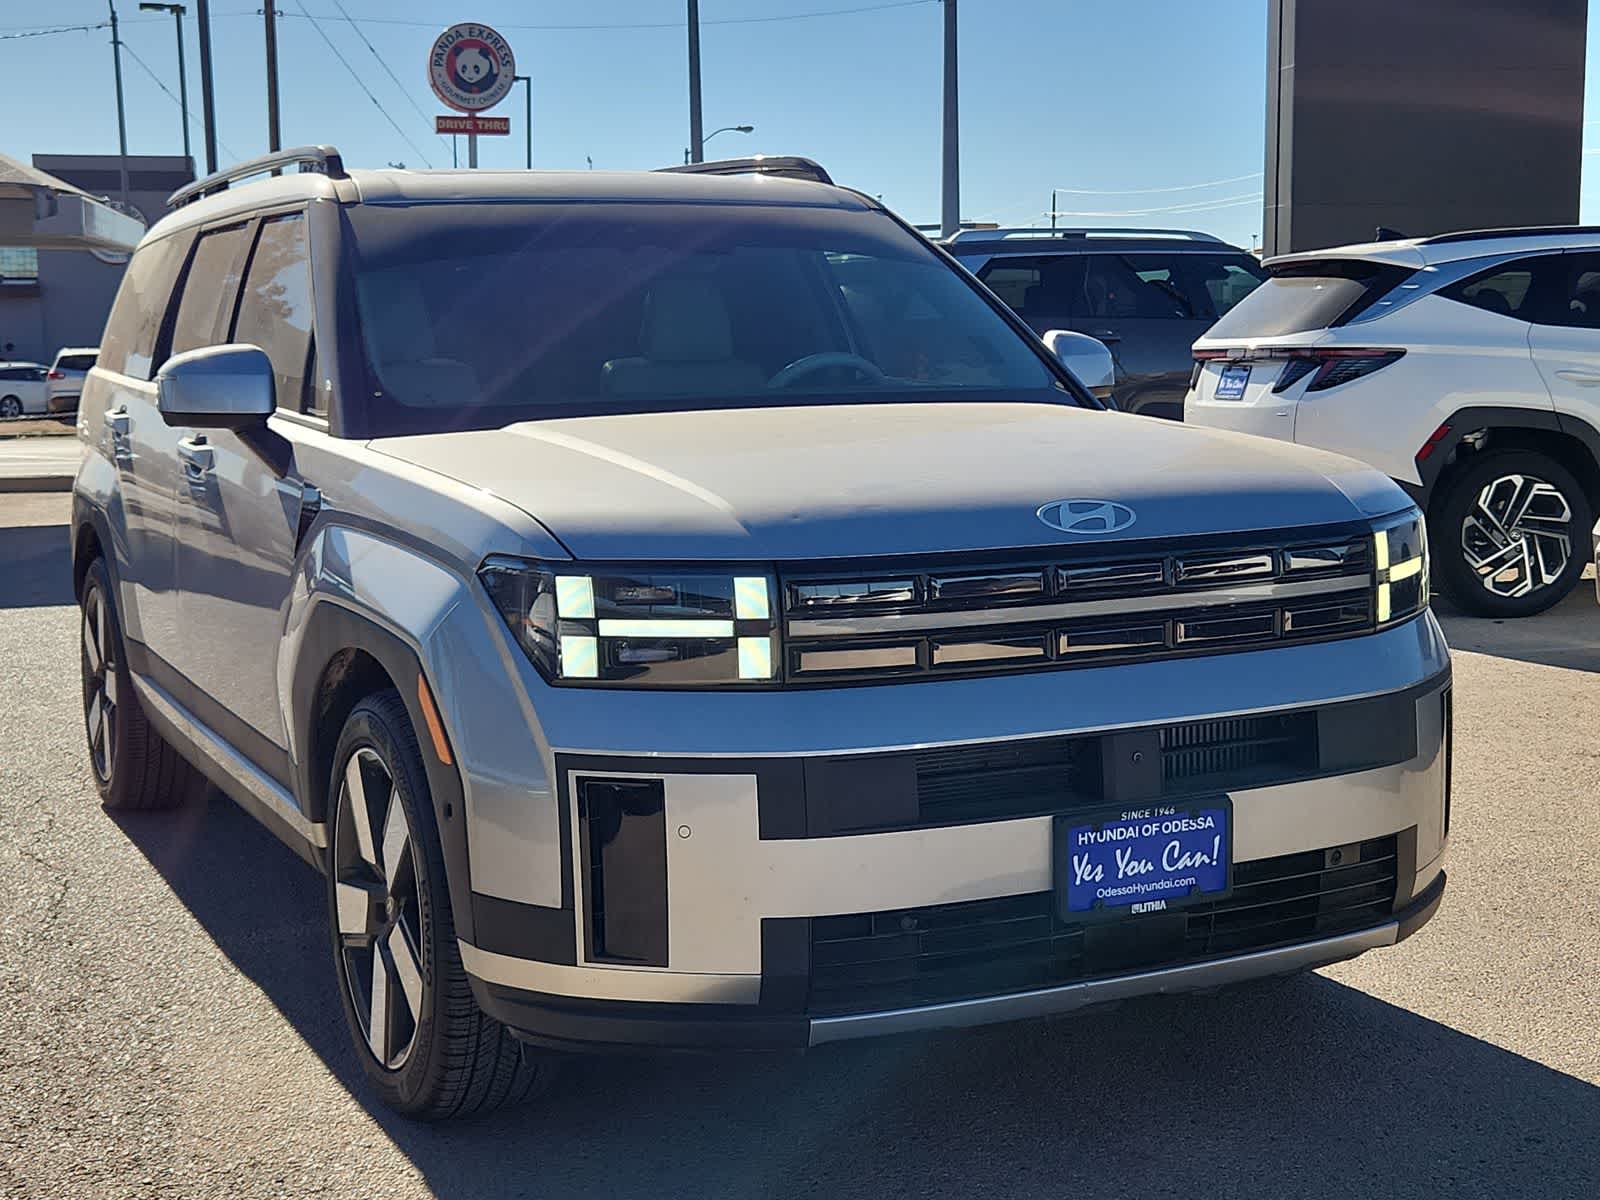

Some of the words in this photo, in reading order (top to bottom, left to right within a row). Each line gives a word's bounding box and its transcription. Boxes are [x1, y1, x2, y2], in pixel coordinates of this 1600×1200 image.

[433, 30, 464, 67] PANDA
[469, 27, 511, 67] EXPRESS
[438, 120, 473, 129] DRIVE
[477, 121, 508, 130] THRU
[1121, 809, 1150, 821] SINCE
[1154, 806, 1176, 818] 1946
[1078, 826, 1139, 846] HYUNDAI
[1141, 823, 1161, 837] OF
[1161, 816, 1215, 833] ODESSA
[1072, 852, 1104, 886] Yes
[1115, 846, 1154, 879] You
[1162, 834, 1220, 872] Can!
[1096, 876, 1196, 898] OdessaHyundai.com
